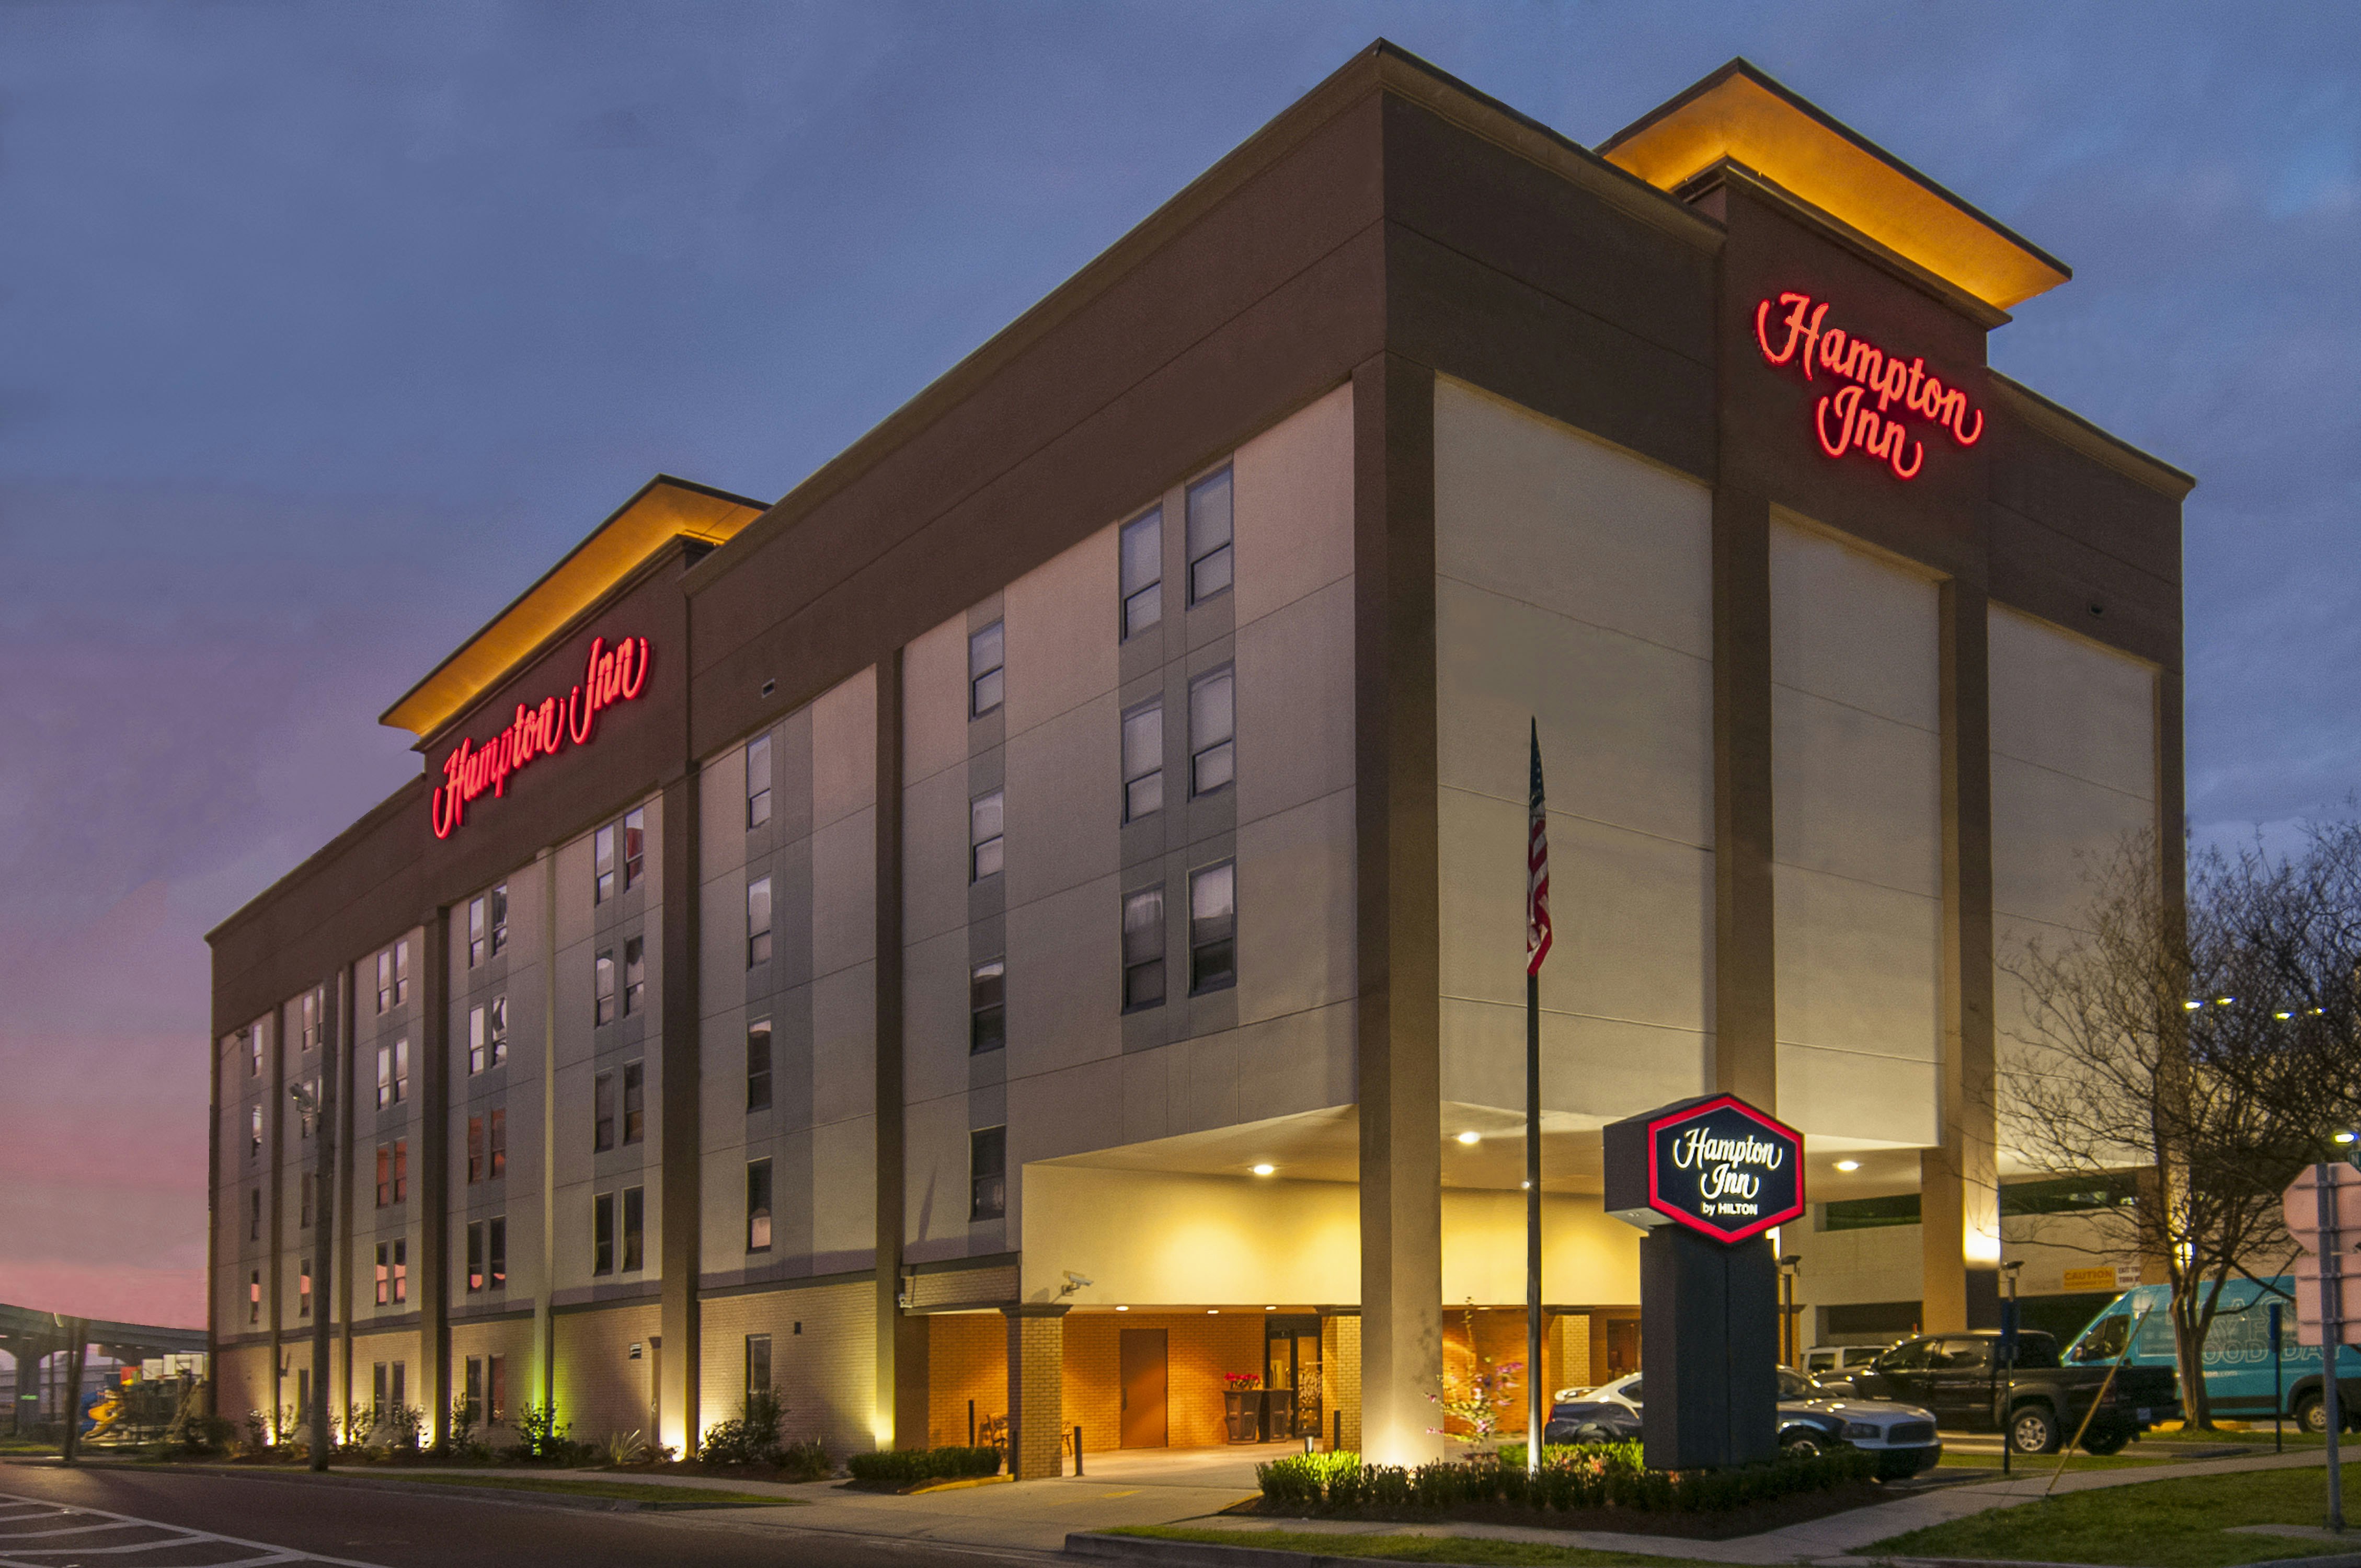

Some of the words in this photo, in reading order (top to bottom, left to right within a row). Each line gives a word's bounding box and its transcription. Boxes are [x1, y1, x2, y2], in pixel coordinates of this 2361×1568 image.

[1756, 291, 1984, 446] Hampton
[1817, 385, 1924, 479] Inn
[432, 696, 566, 839] Hampton
[570, 637, 648, 745] Inn
[1674, 1127, 1783, 1170] Hampton
[1700, 1163, 1760, 1199] Inn
[1701, 1201, 1716, 1216] by
[1717, 1202, 1758, 1215] HILTON
[2065, 1270, 2113, 1281] CAUTION
[2202, 1339, 2269, 1365] OOD
